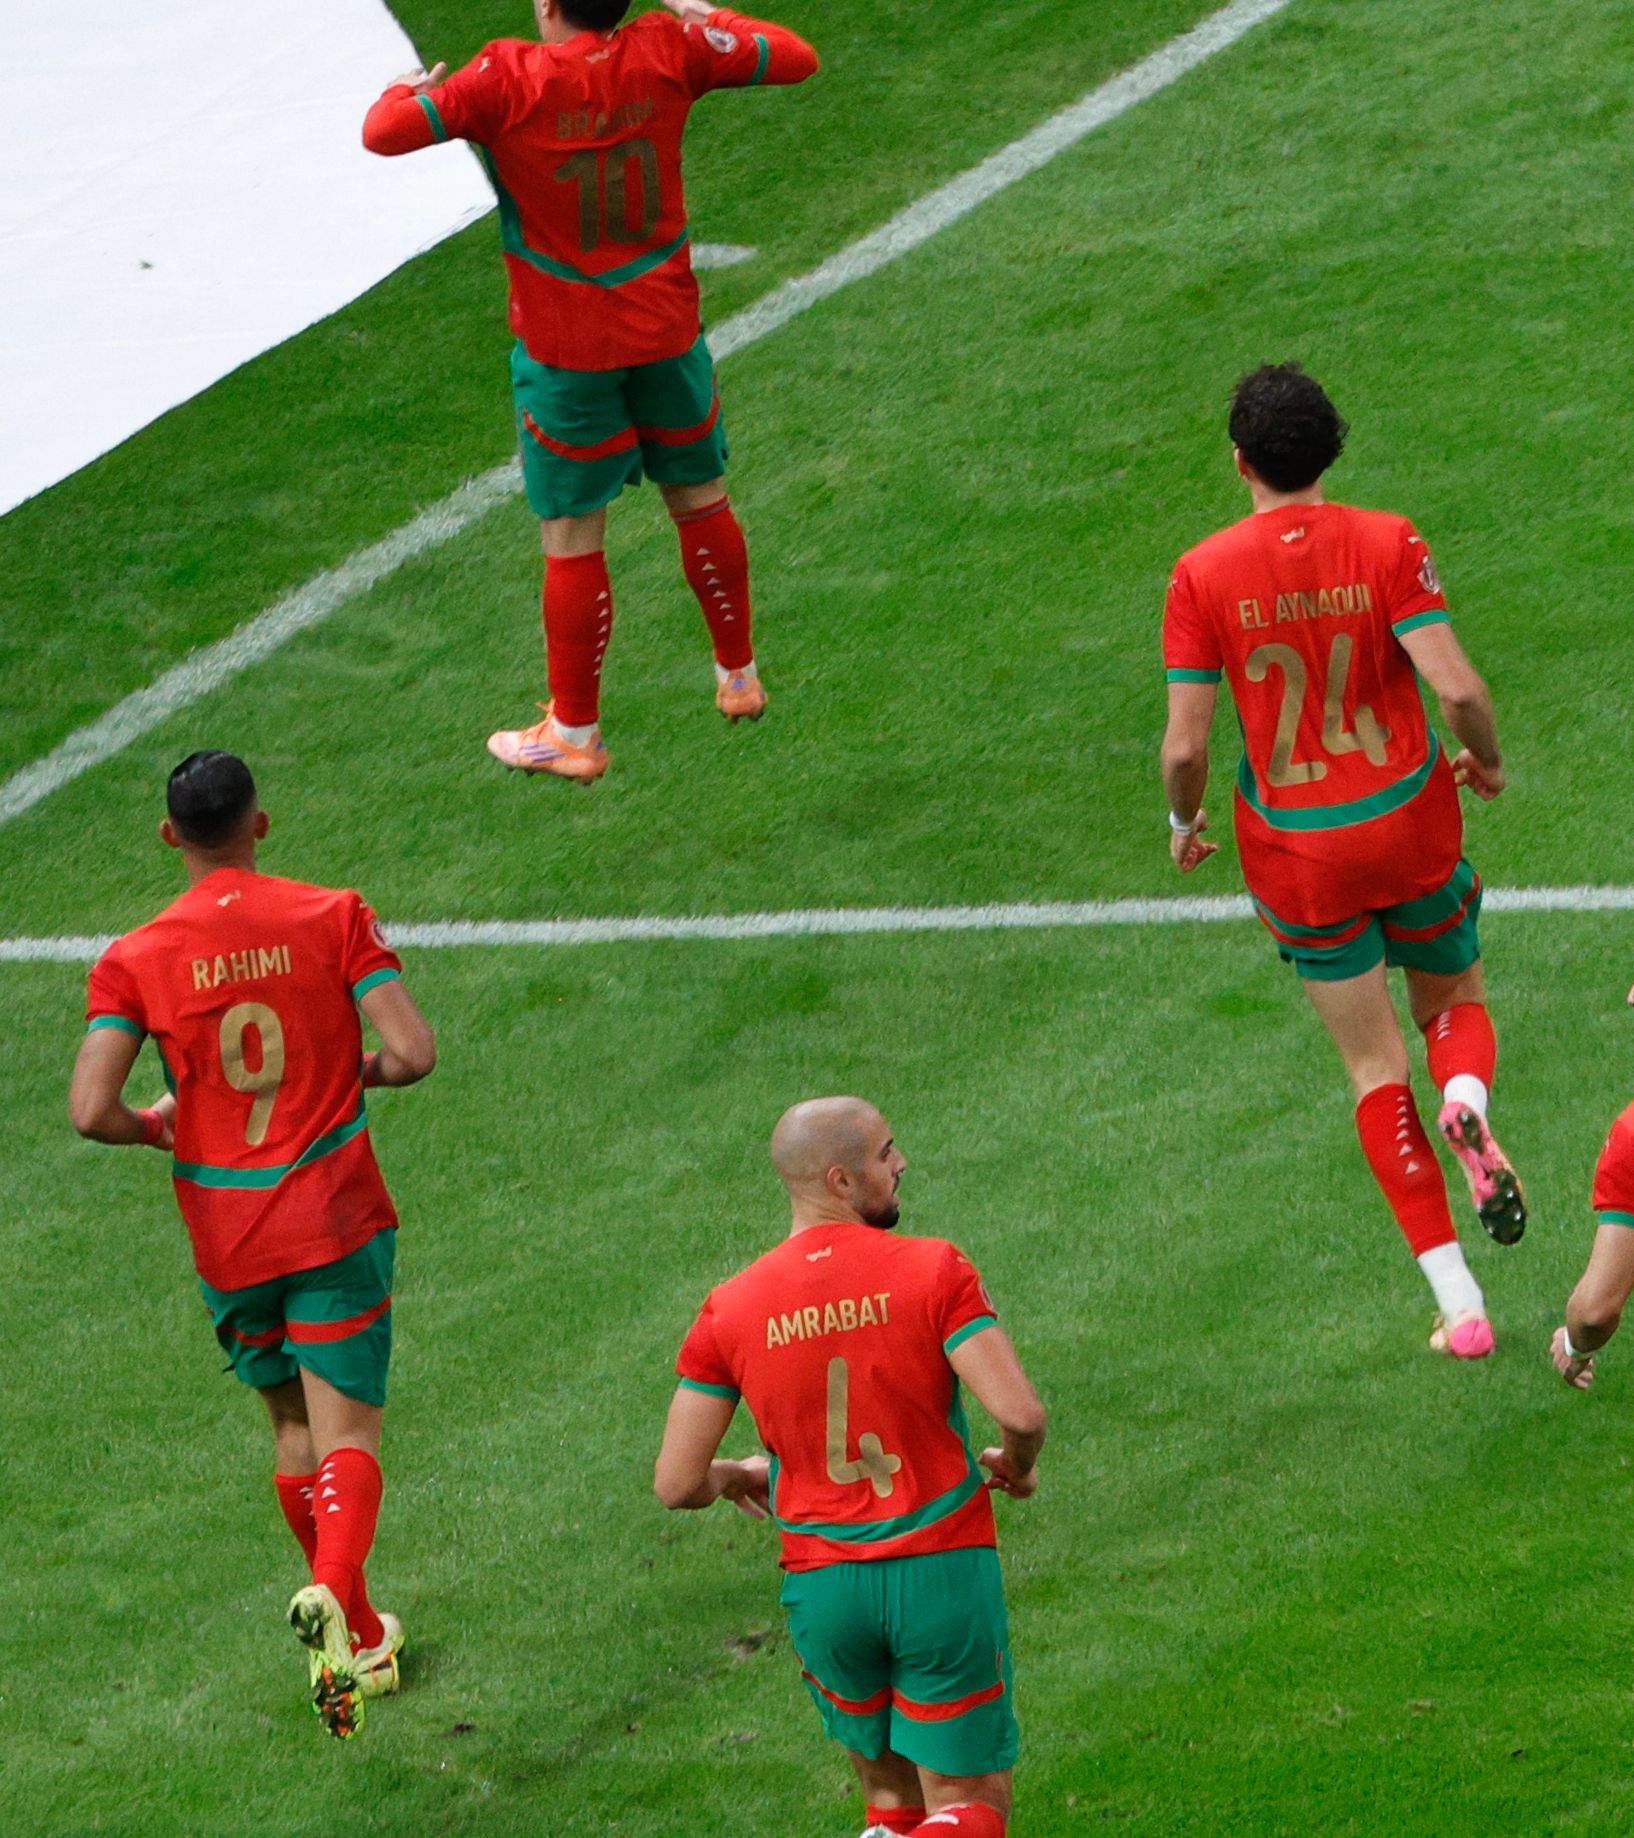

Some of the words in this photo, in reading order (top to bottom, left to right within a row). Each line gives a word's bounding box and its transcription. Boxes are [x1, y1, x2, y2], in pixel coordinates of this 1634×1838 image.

[554, 138, 660, 253] 10
[1238, 598, 1269, 629] EL
[1275, 583, 1373, 624] AYNAOUI
[1245, 633, 1392, 787] 24
[191, 945, 293, 991] RAHIMI
[219, 1002, 286, 1146] 9
[766, 1292, 891, 1349] AMRABAT
[826, 1356, 902, 1498] 4
